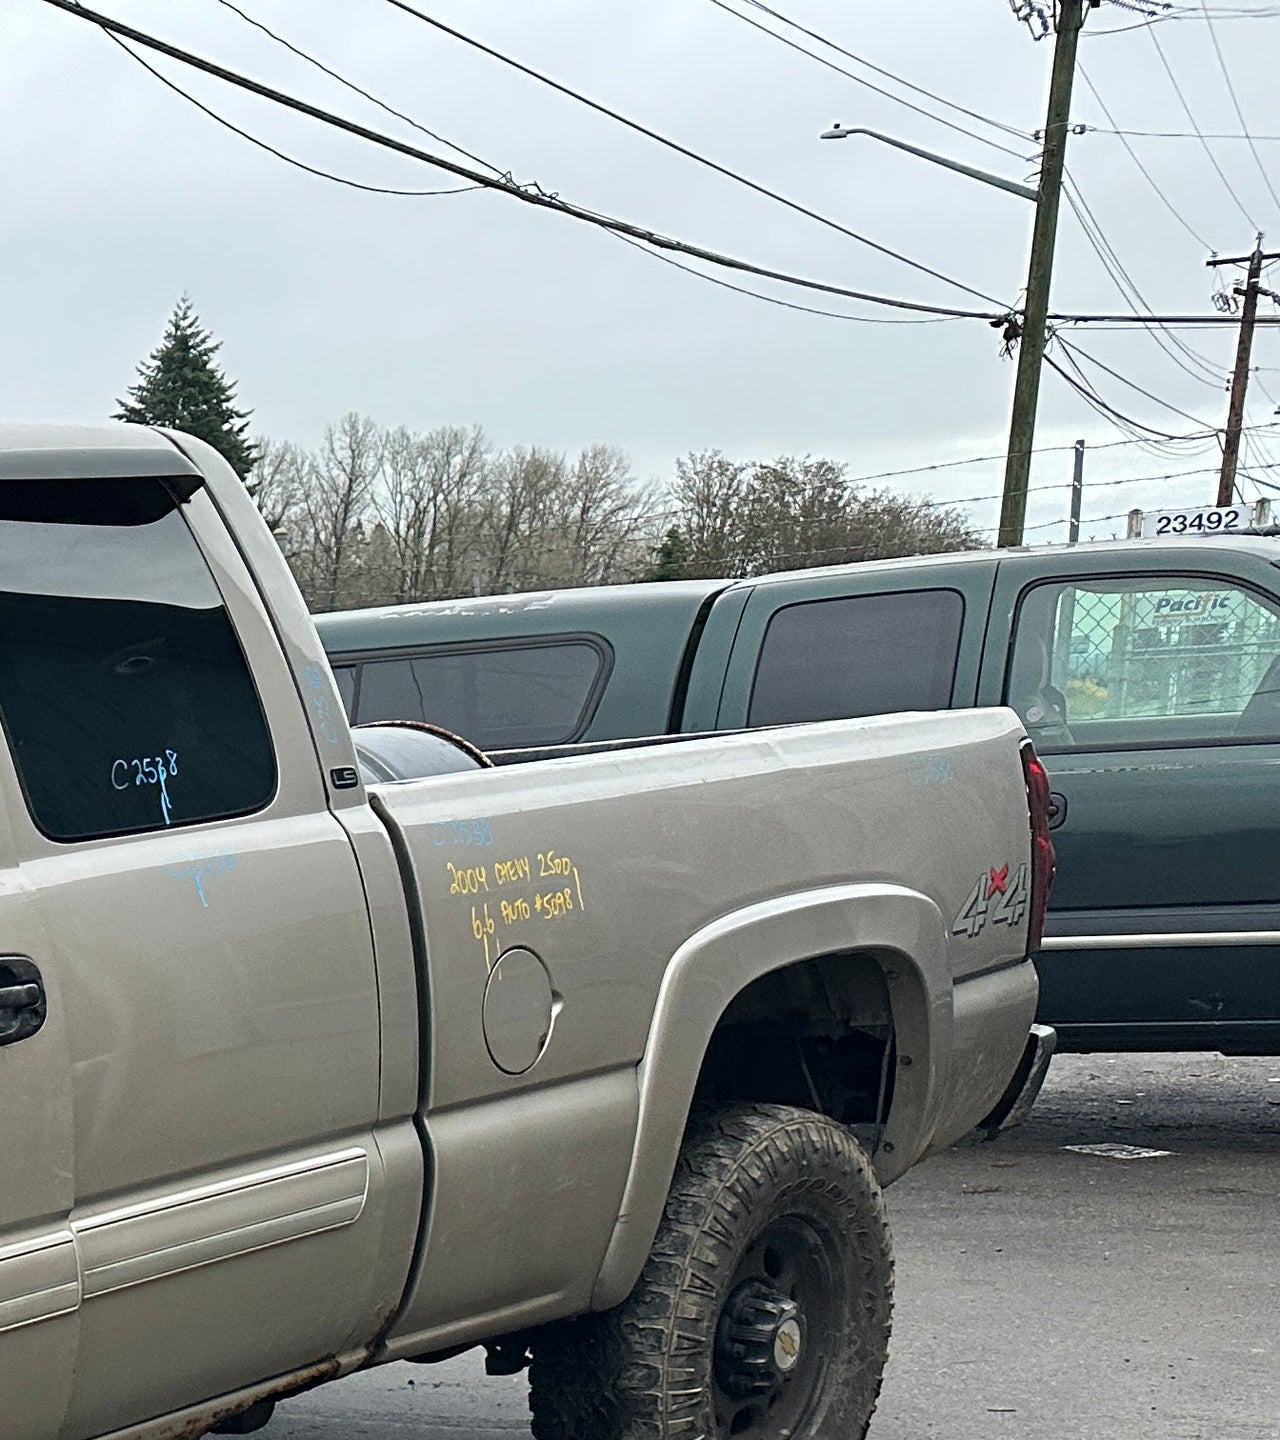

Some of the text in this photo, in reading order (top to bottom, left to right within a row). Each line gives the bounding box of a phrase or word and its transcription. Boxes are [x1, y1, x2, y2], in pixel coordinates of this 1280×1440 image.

[1156, 510, 1240, 535] 23492
[1154, 591, 1231, 614] Pacific
[332, 769, 357, 785] LS
[446, 850, 572, 895] 2004 CHEVY 2500
[471, 902, 495, 940] 6.6
[500, 898, 531, 925] AUTO
